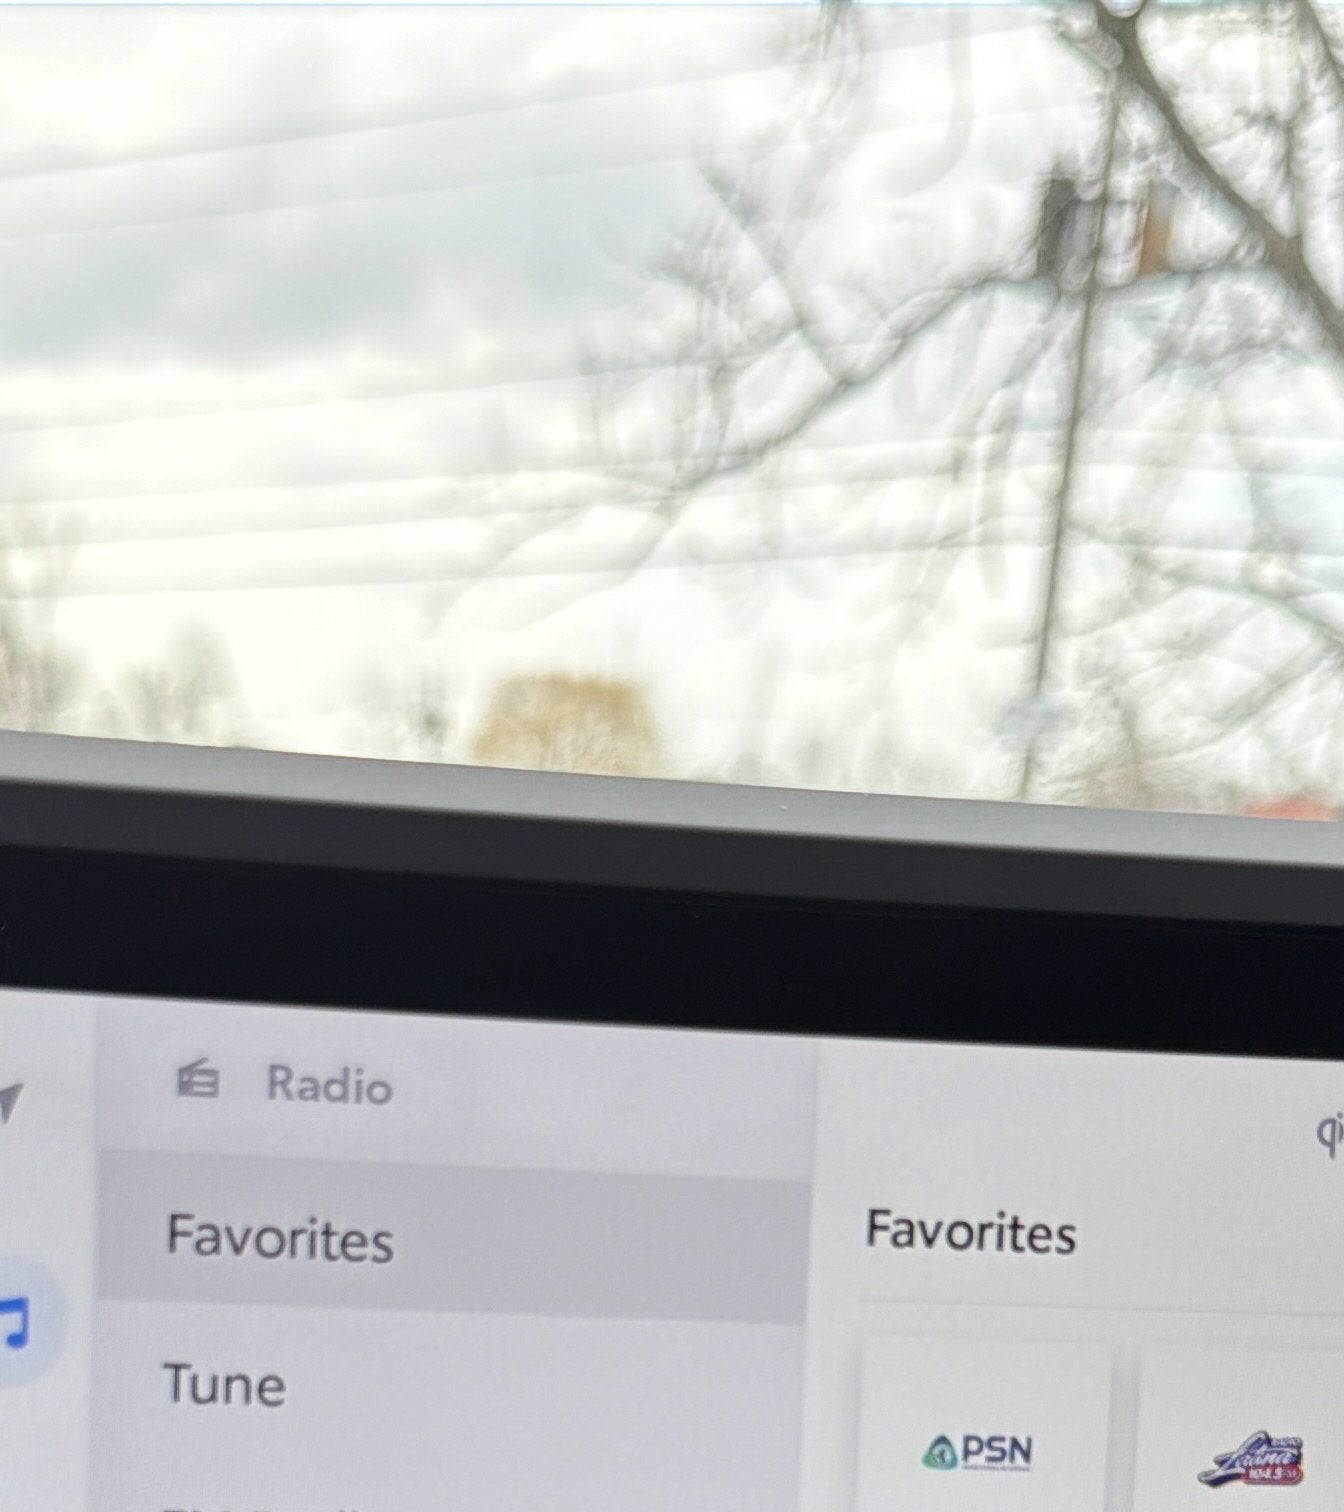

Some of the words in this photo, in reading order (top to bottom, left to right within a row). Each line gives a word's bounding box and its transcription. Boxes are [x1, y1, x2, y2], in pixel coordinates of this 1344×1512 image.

[265, 1063, 395, 1107] Radio
[167, 1212, 395, 1265] Favorites
[866, 1207, 1078, 1257] Favorites
[162, 1361, 287, 1408] Tune
[961, 1434, 1033, 1464] PSN
